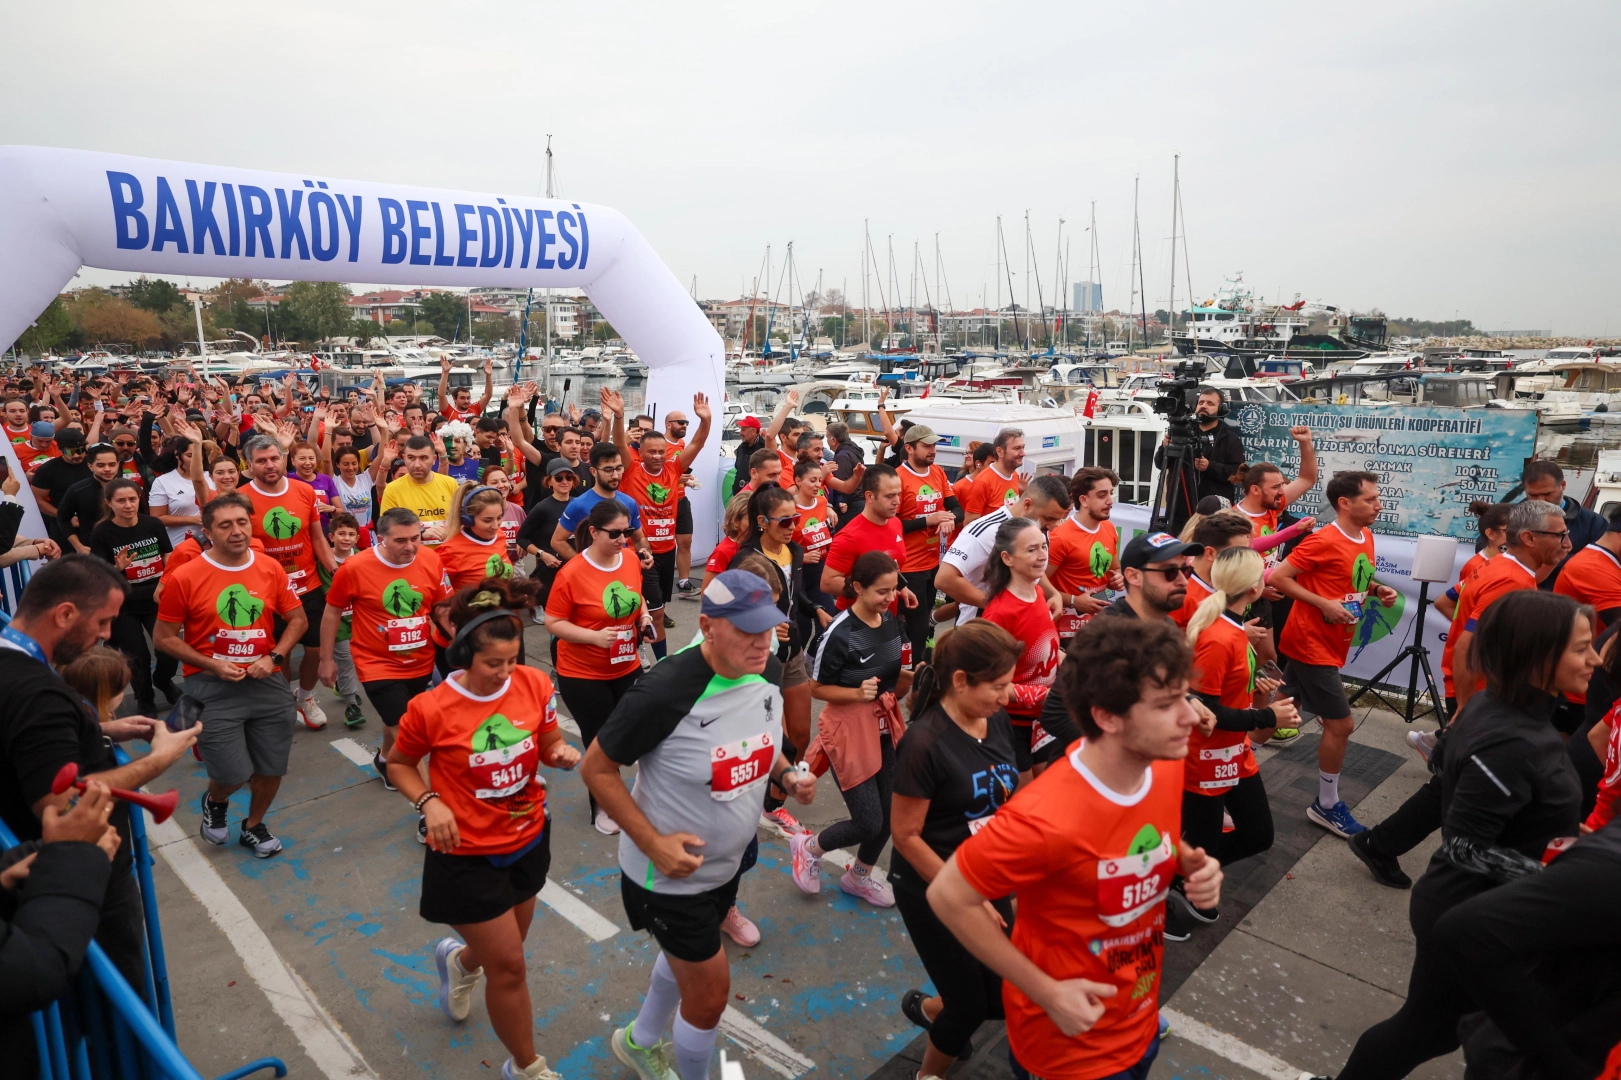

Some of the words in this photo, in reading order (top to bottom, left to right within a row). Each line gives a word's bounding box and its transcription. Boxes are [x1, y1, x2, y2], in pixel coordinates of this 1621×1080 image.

[106, 170, 363, 262] BAKIRKÖY
[378, 197, 589, 270] BELEDİYESİ
[1269, 412, 1288, 426] S.S.
[1338, 415, 1353, 429] SU
[1355, 414, 1406, 431] ÜRÜNLERİ
[1408, 418, 1482, 434] KOOPERATİFİ
[1239, 437, 1289, 449] IKLARIN
[1292, 438, 1345, 453] DİZDE
[1347, 442, 1376, 454] YOK
[1378, 444, 1416, 456] OLMA
[1418, 444, 1491, 460] SÜRELERİ
[1364, 461, 1412, 474] ÇAKMAK
[1456, 466, 1477, 477] 100
[1480, 469, 1498, 478] YIL
[1461, 480, 1475, 490] 50
[1477, 483, 1497, 492] YIL
[1306, 494, 1321, 503] YIL
[1461, 494, 1473, 503] 15
[418, 508, 445, 517] Zinde
[1287, 505, 1303, 513] 100
[1304, 506, 1320, 515] YIL
[1375, 560, 1398, 569] KASIM
[137, 566, 156, 578] 5962
[400, 629, 421, 642] 5192
[228, 643, 254, 655] 5949
[731, 759, 759, 786] 5551
[1214, 762, 1238, 778] 5203
[1121, 874, 1160, 908] 5152
